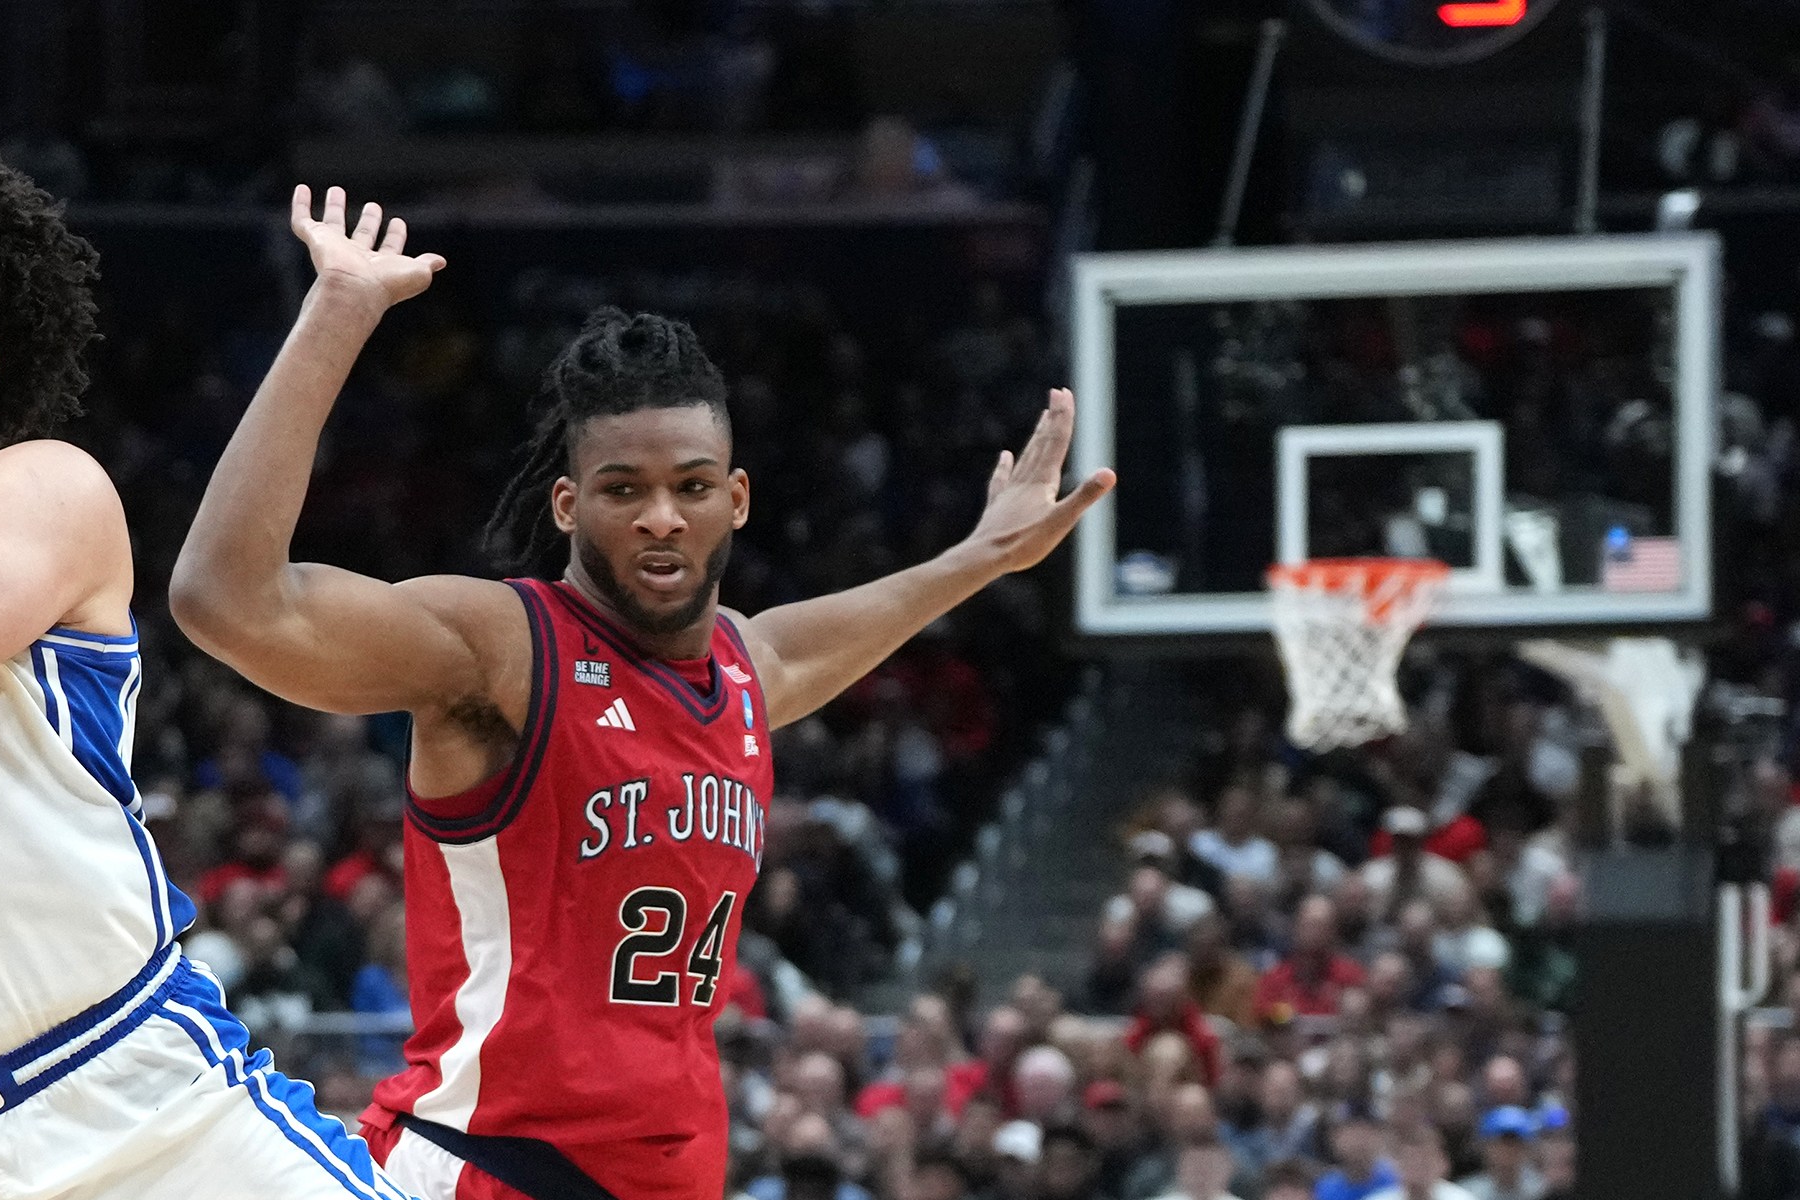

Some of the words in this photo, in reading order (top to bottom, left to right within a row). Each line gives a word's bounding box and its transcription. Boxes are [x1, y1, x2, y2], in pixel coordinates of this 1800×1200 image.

[574, 671, 611, 687] CHANGE
[575, 660, 588, 672] BE
[589, 661, 609, 674] THE
[580, 779, 654, 860] ST.
[609, 886, 736, 1007] 24
